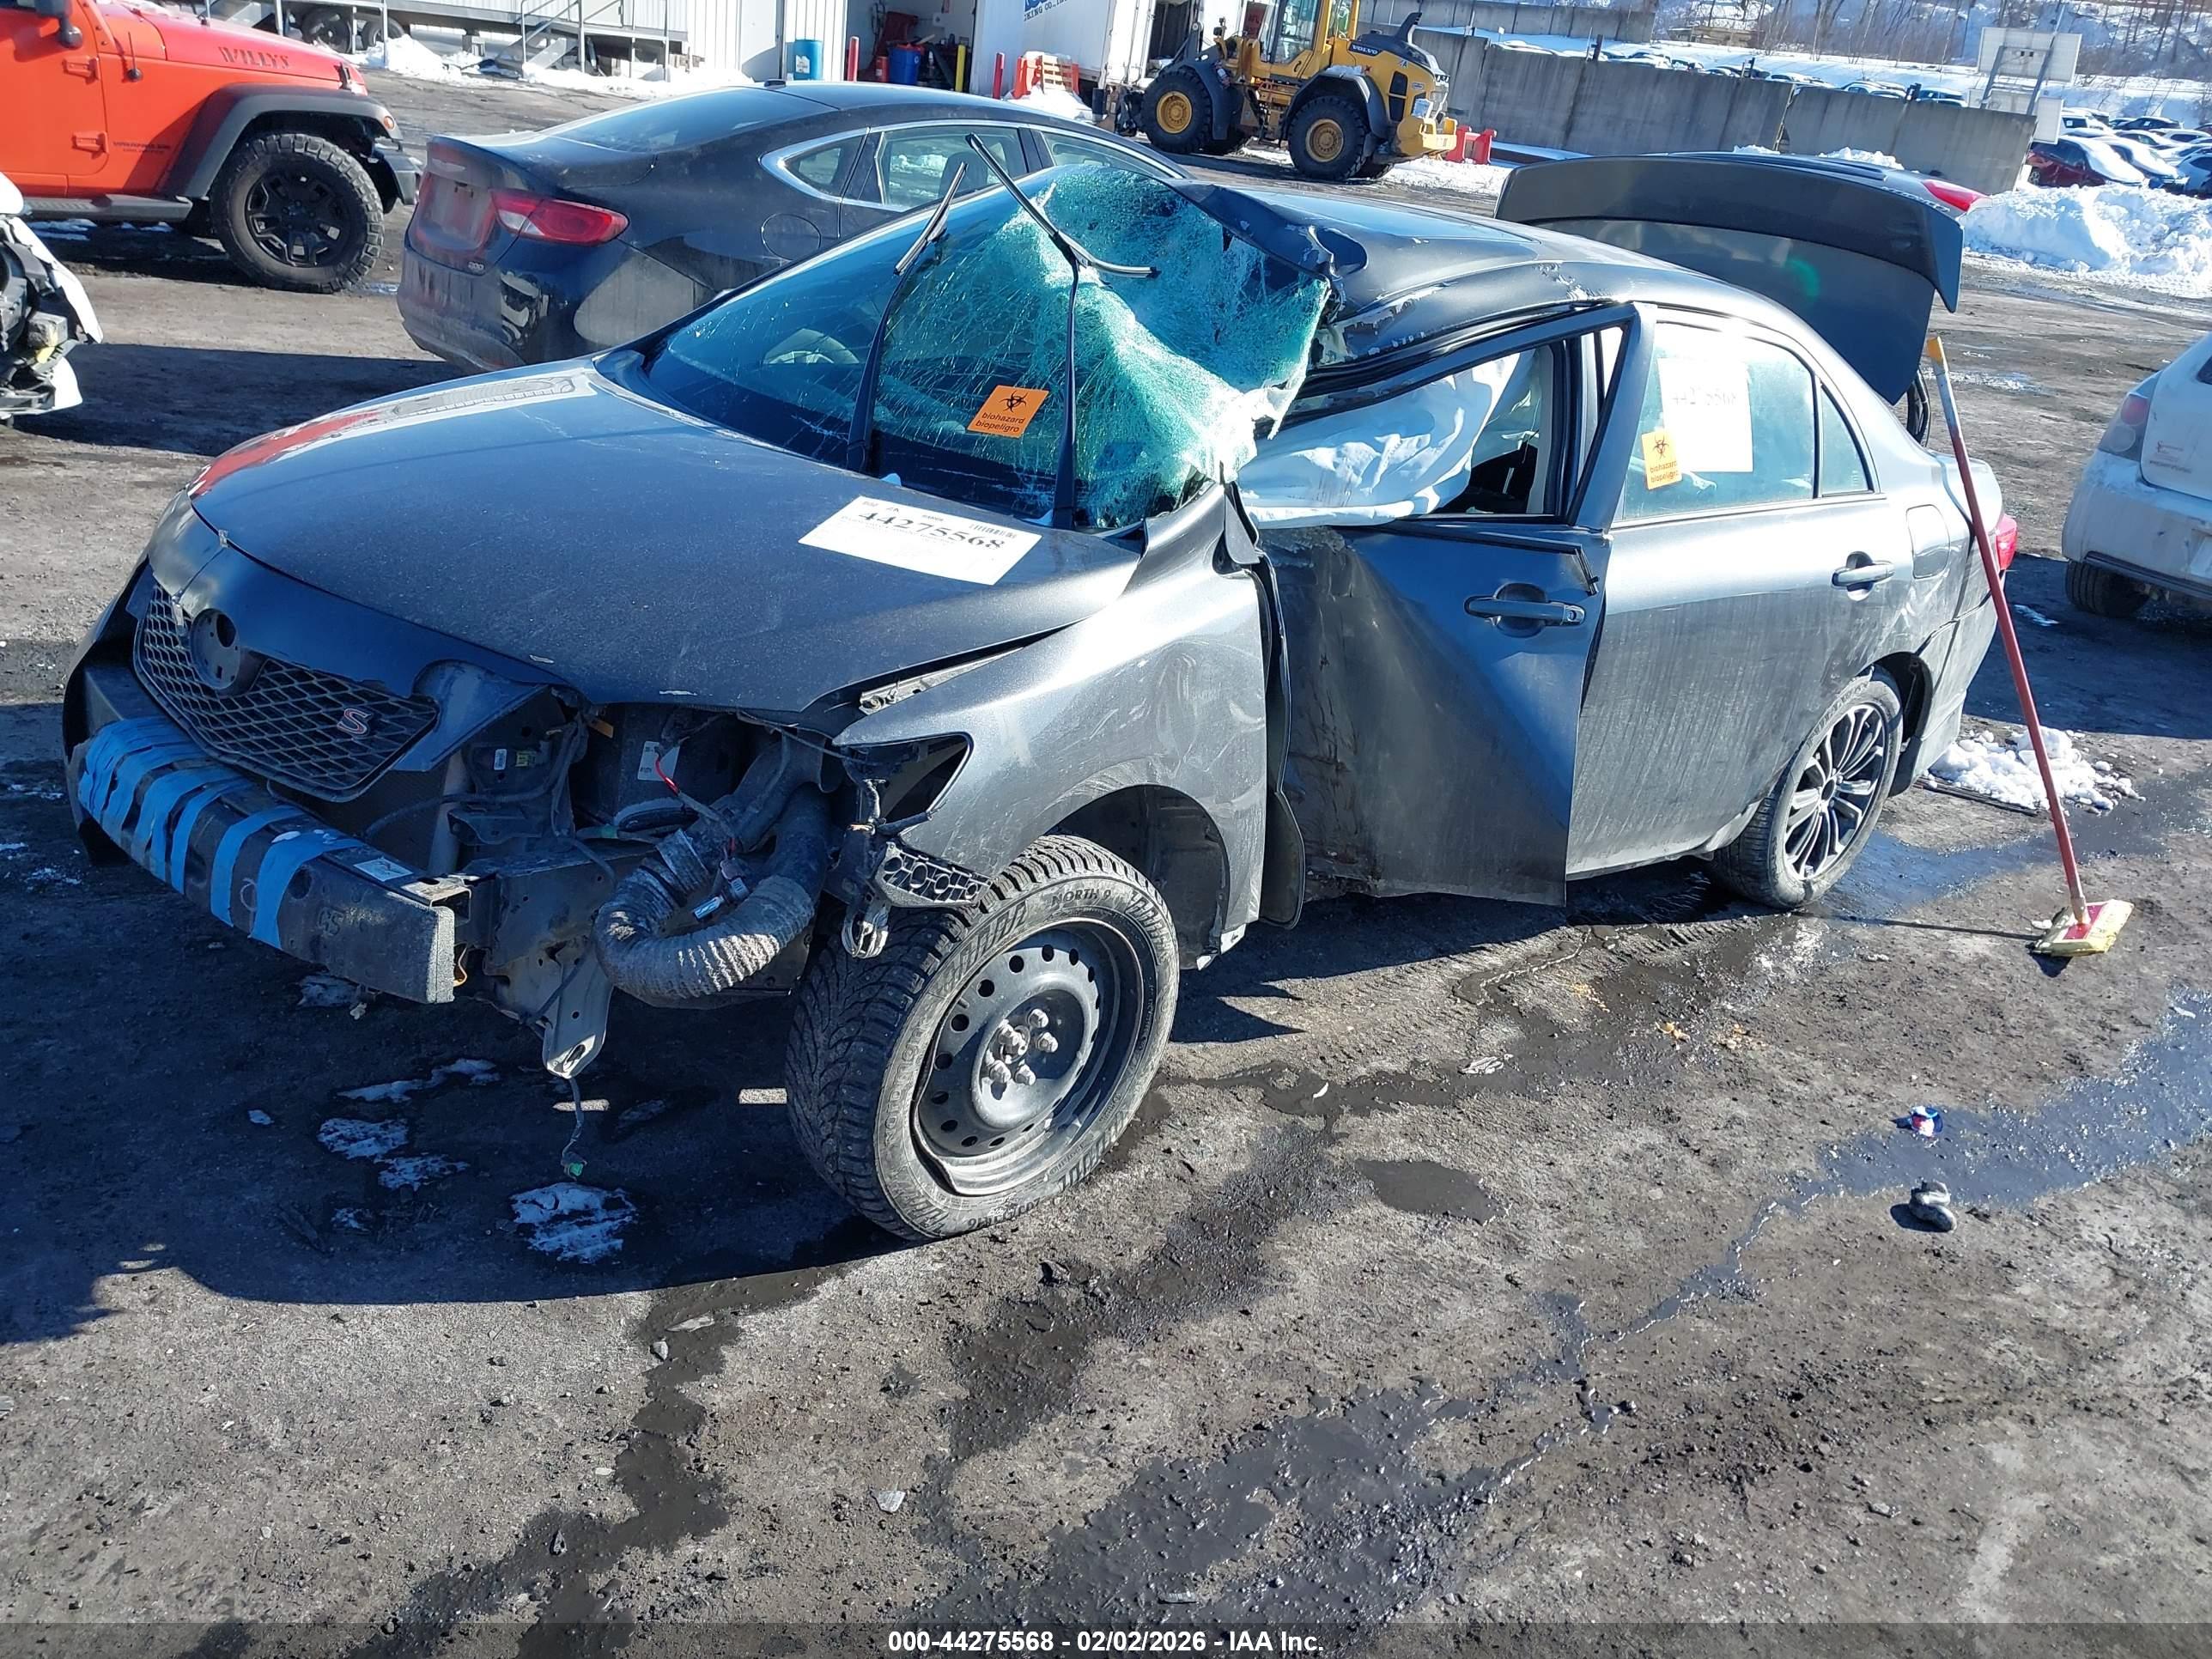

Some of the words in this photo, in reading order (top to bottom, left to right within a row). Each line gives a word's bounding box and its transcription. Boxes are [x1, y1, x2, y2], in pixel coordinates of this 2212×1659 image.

[1352, 44, 1379, 56] VOLVO
[975, 420, 1020, 433] biopeligro
[981, 412, 1026, 424] biohazard
[859, 511, 1006, 550] 44275568
[336, 708, 372, 735] S
[1051, 887, 1100, 908] NORTH
[1102, 888, 1112, 901] 9
